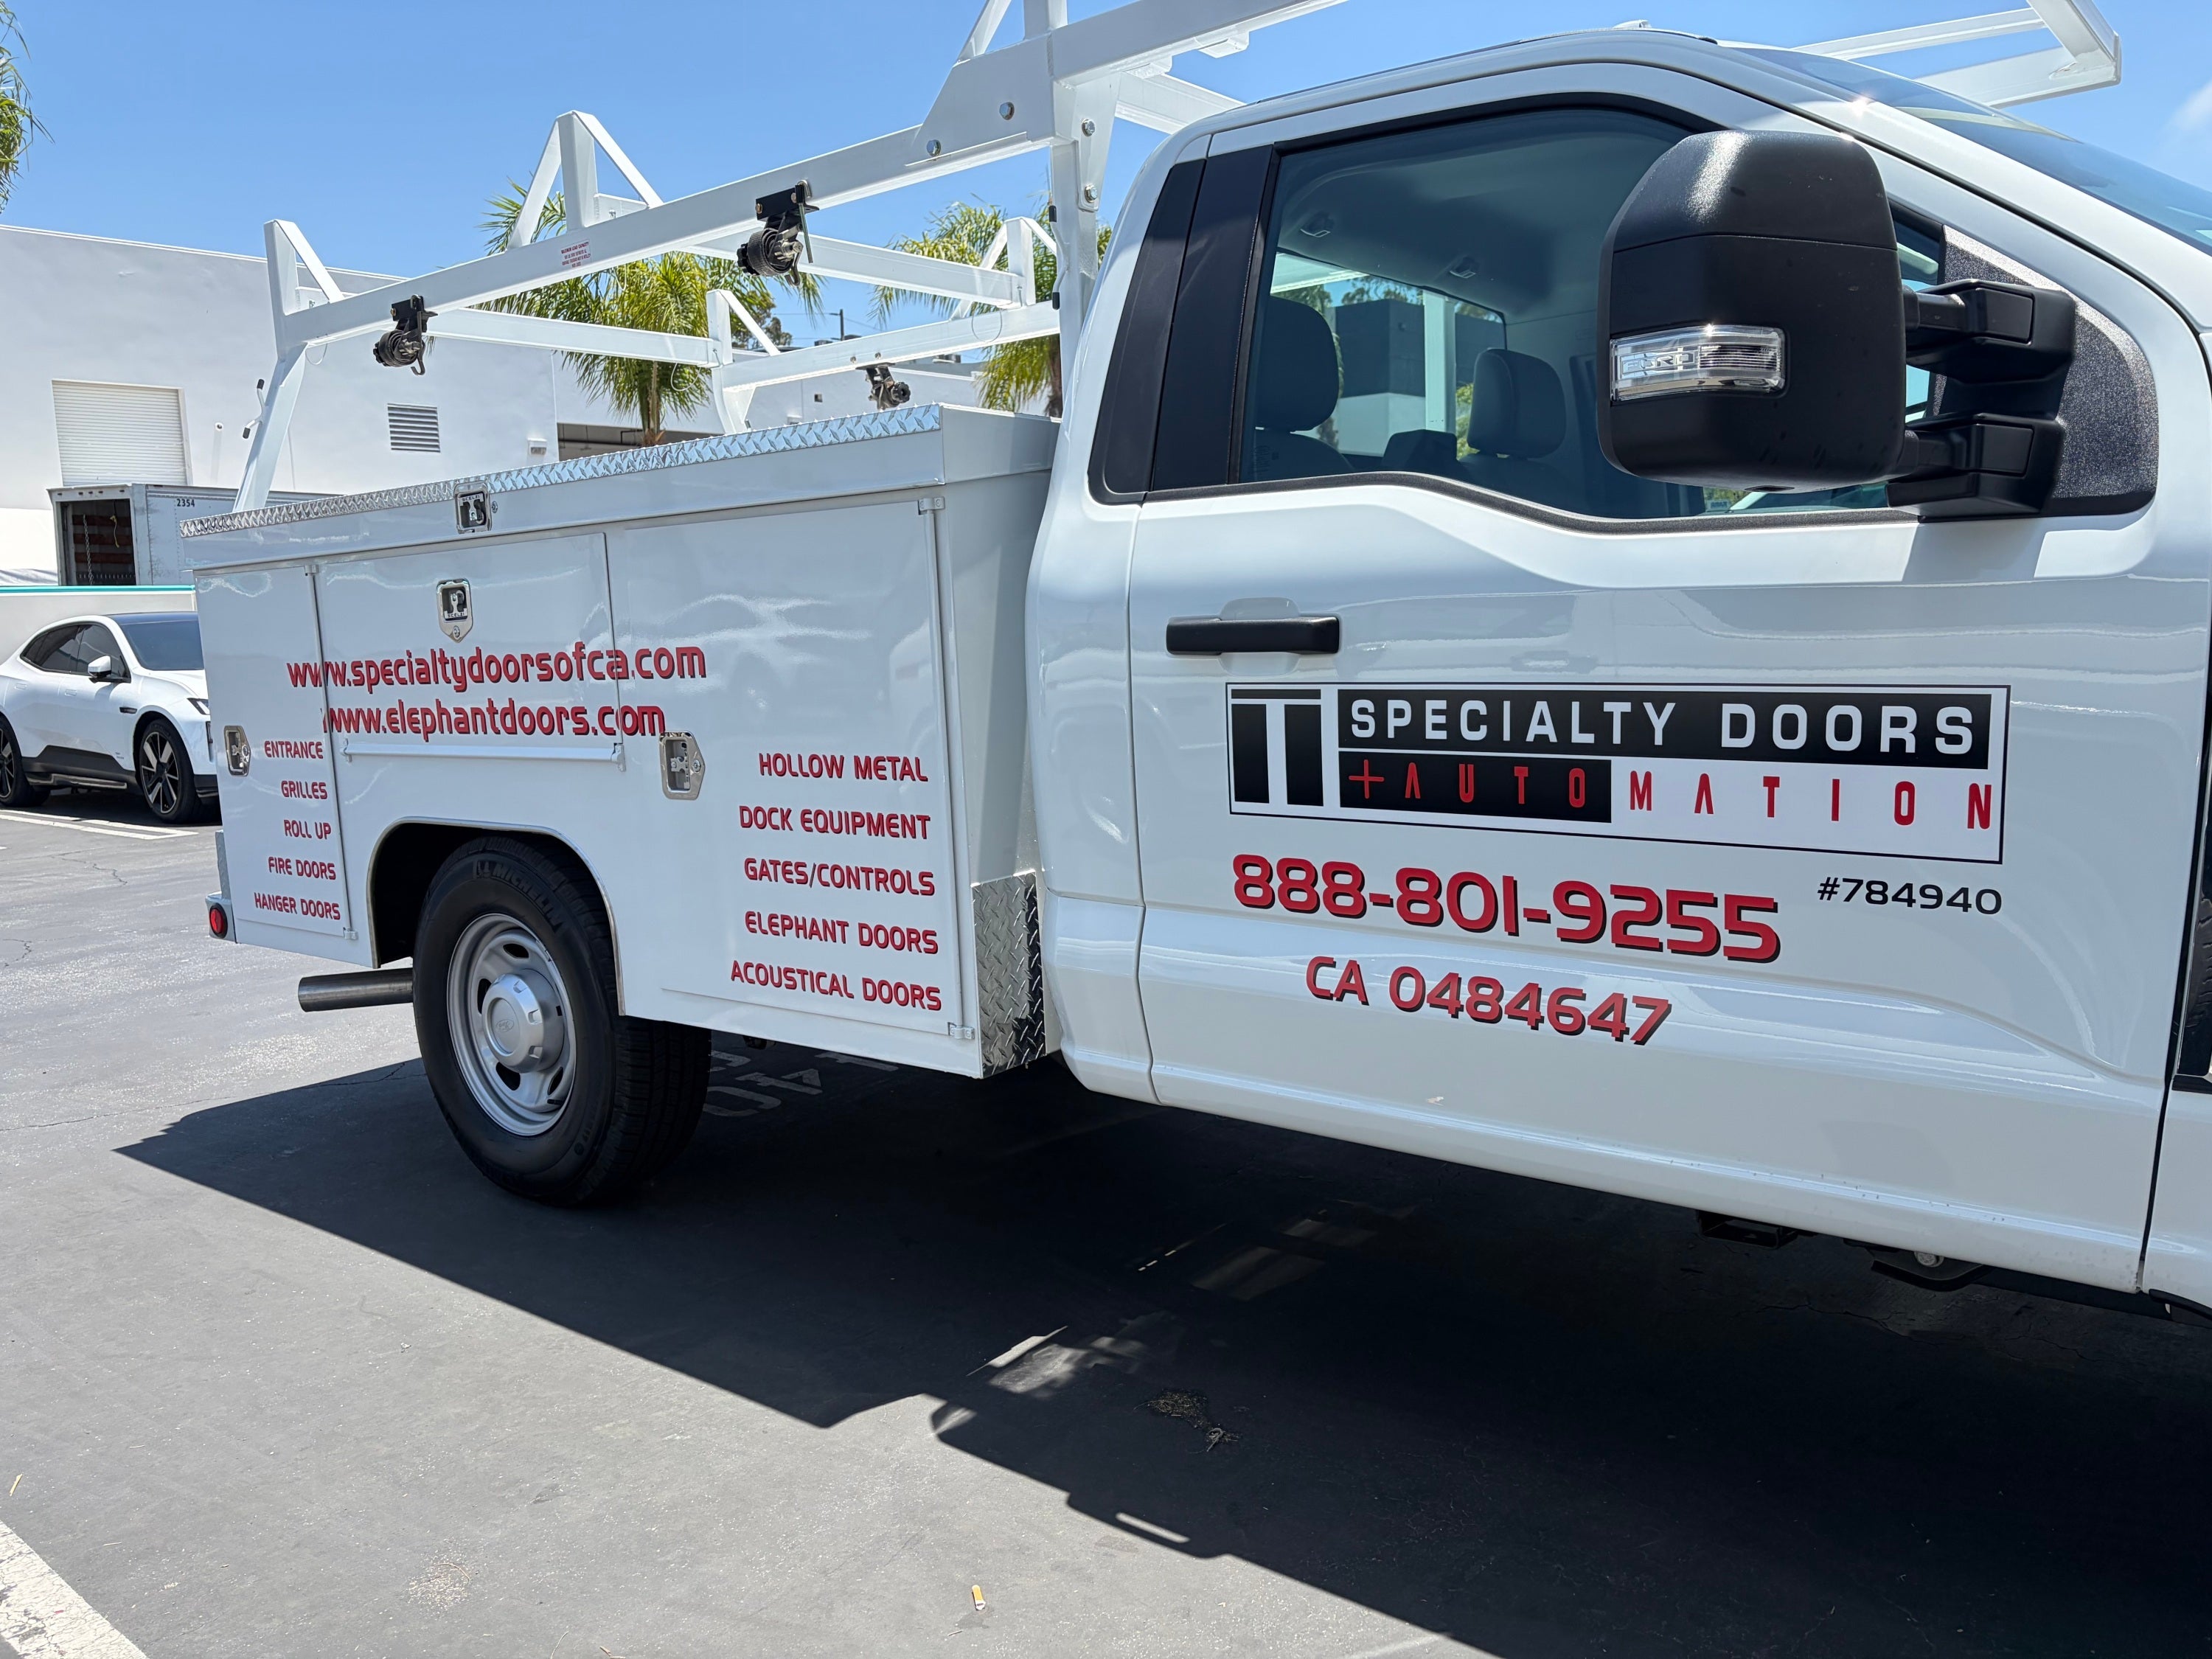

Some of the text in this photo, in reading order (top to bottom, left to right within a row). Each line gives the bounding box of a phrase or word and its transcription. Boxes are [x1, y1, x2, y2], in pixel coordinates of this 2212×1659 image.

[176, 498, 195, 507] 2354
[1351, 699, 1973, 755] SPECIALTY DOORS
[264, 740, 324, 759] ENTRANCE
[759, 753, 928, 782] HOLLOW METAL
[281, 780, 328, 799] GRILLES
[283, 819, 332, 839] ROLL UP
[739, 805, 931, 839] DOCK EQUIPMENT
[268, 856, 336, 880] FIRE DOORS
[744, 858, 935, 897] GATES/CONTROLS
[254, 891, 341, 920] HANGER DOORS
[1232, 853, 1781, 963] 888-801-9255
[1817, 877, 2003, 915] #784940
[745, 911, 939, 954] ELEPHANT DOORS
[731, 960, 942, 1011] ACOUSTICAL DOORS
[1306, 956, 1672, 1046] CA 0484647
